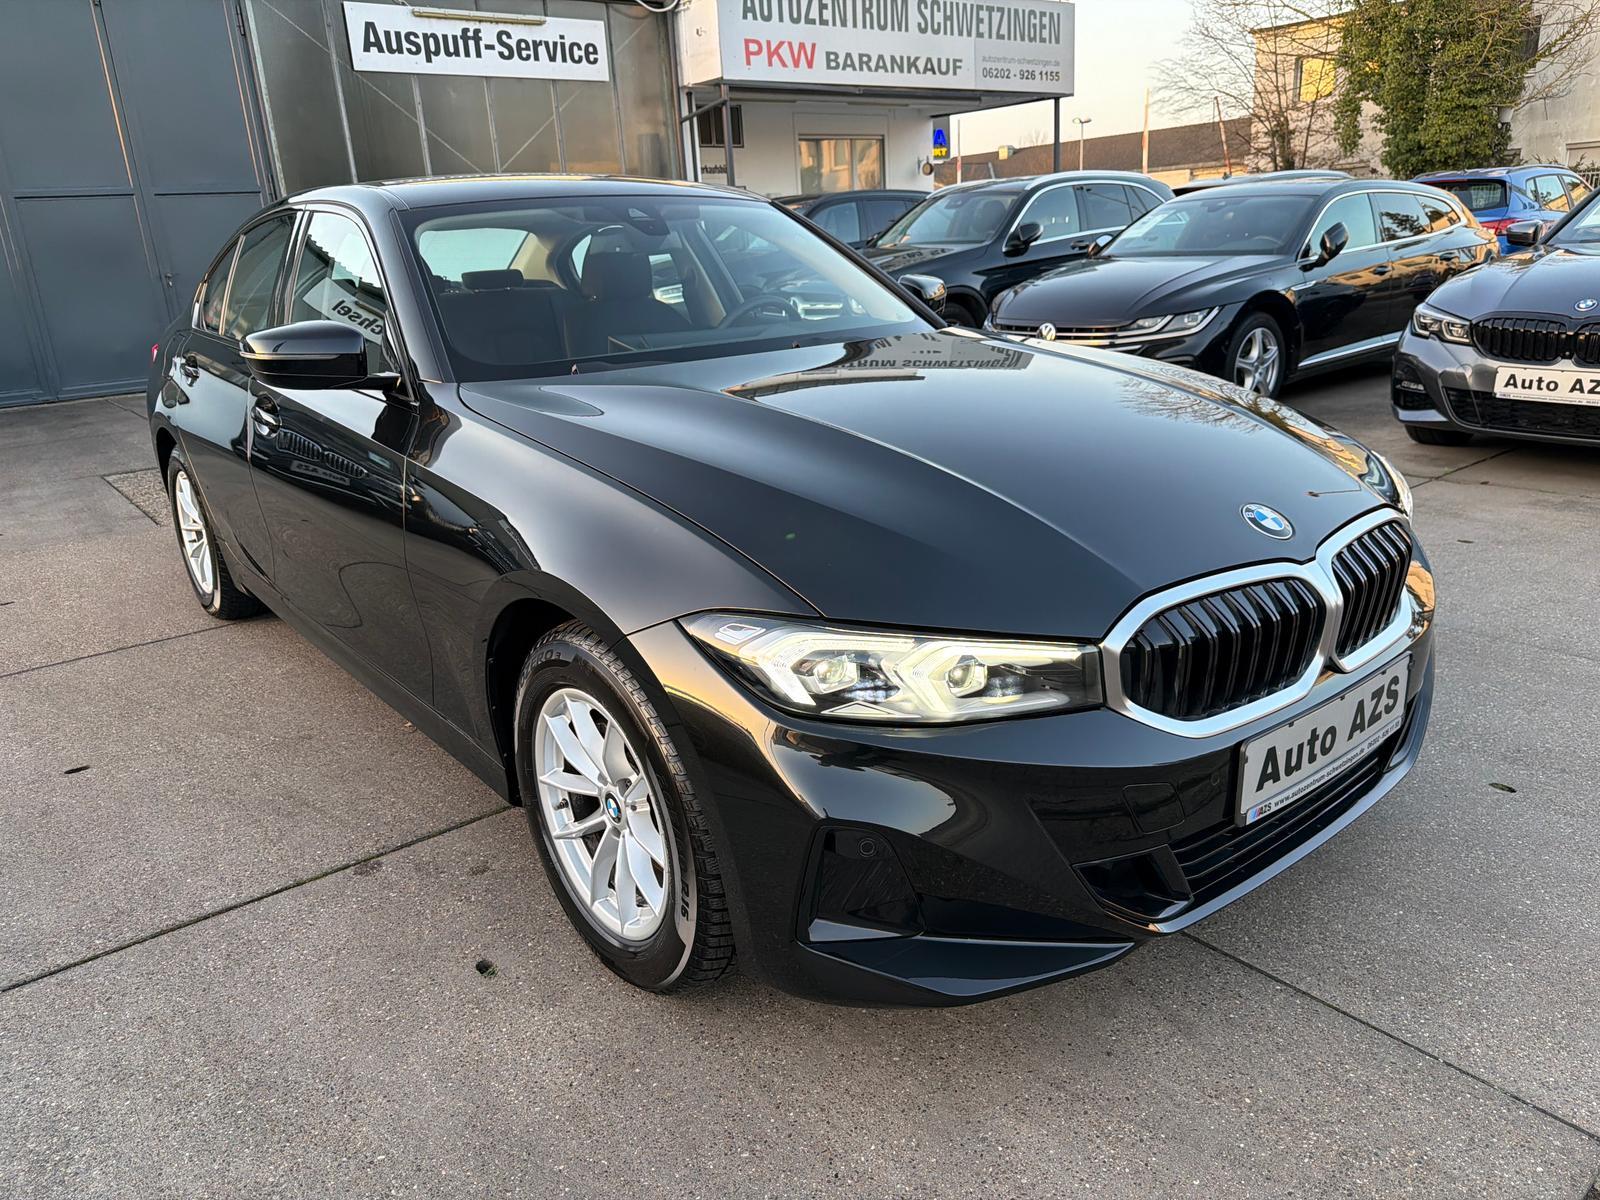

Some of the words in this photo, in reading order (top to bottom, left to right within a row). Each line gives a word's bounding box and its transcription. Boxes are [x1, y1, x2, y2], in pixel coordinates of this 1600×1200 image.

[362, 21, 599, 65] Auspuff-Service
[917, 0, 1061, 45] SCHWETZINGEN
[743, 38, 817, 70] PKW
[825, 51, 963, 76] BARANKAUF
[982, 67, 1011, 79] 06202
[1019, 69, 1036, 80] 926
[1038, 70, 1060, 82] 1155
[1503, 373, 1559, 392] Auto
[1255, 725, 1337, 793] Auto
[1347, 675, 1400, 742] AZS
